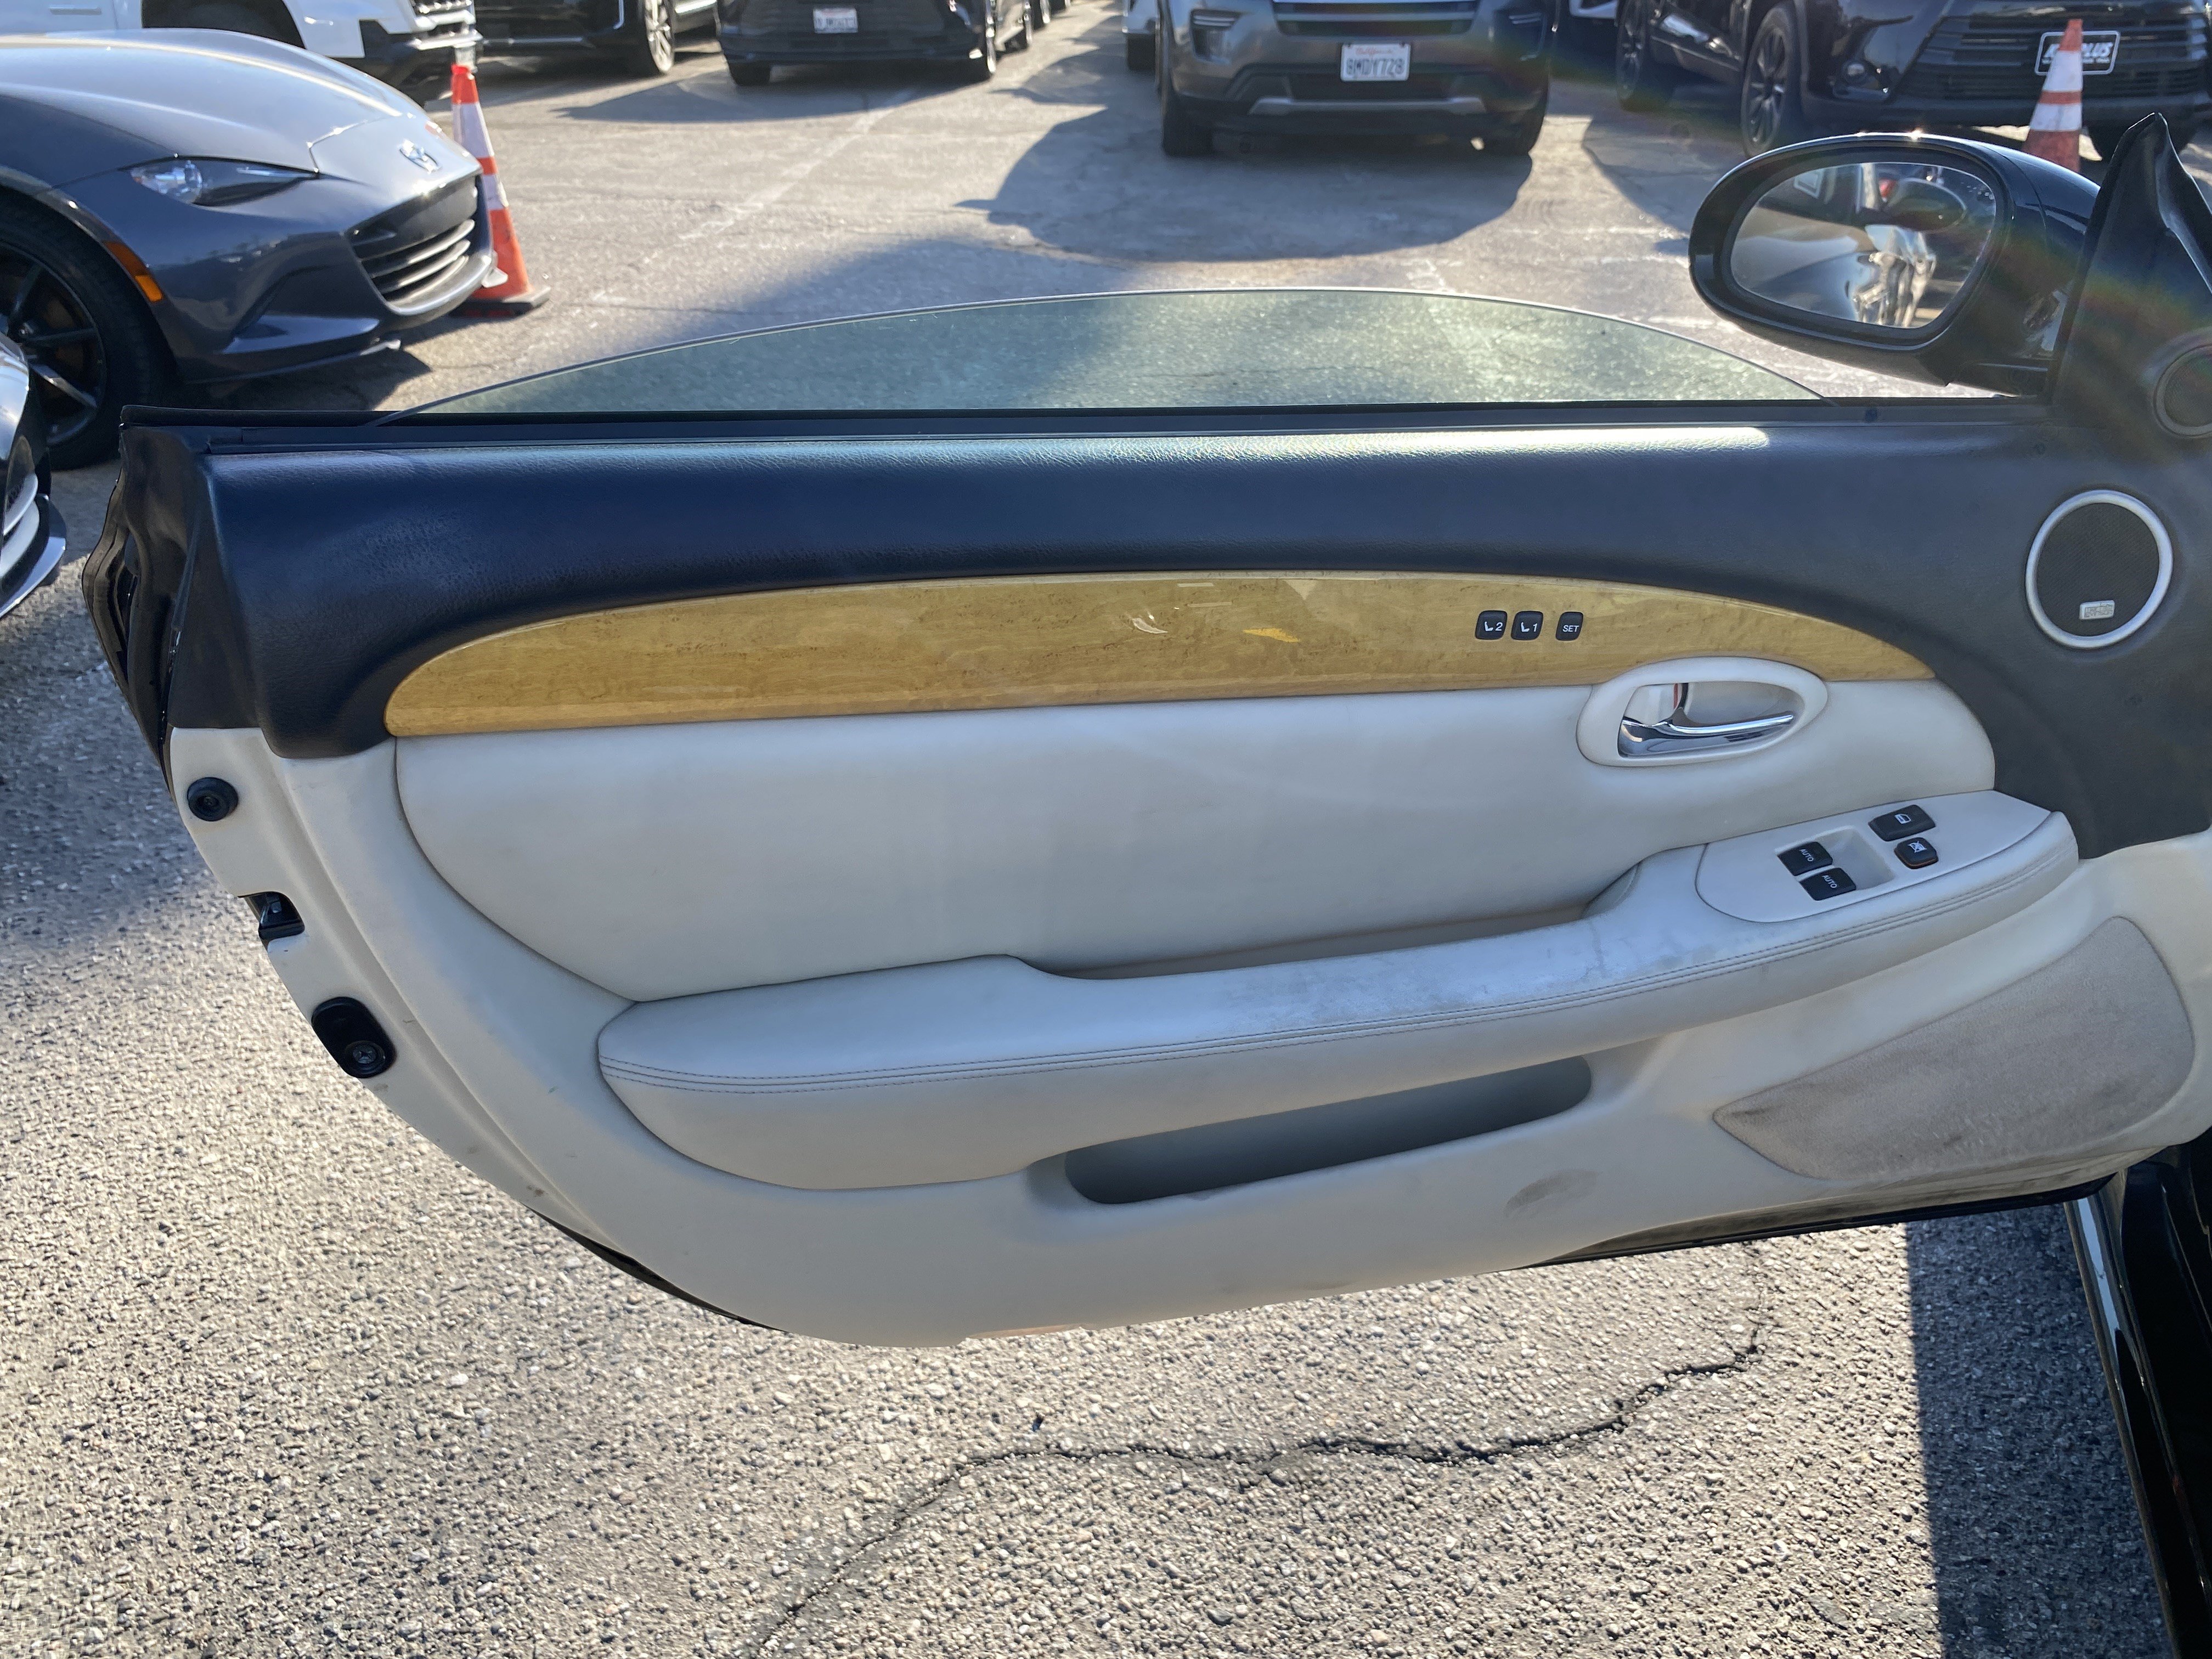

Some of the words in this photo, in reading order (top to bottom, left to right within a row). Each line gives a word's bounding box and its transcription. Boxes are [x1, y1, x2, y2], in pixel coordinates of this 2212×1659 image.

[1495, 622, 1503, 631] 2
[1533, 623, 1538, 632] 1
[1799, 849, 1814, 862] AUTO
[1822, 875, 1837, 888] AUTO
